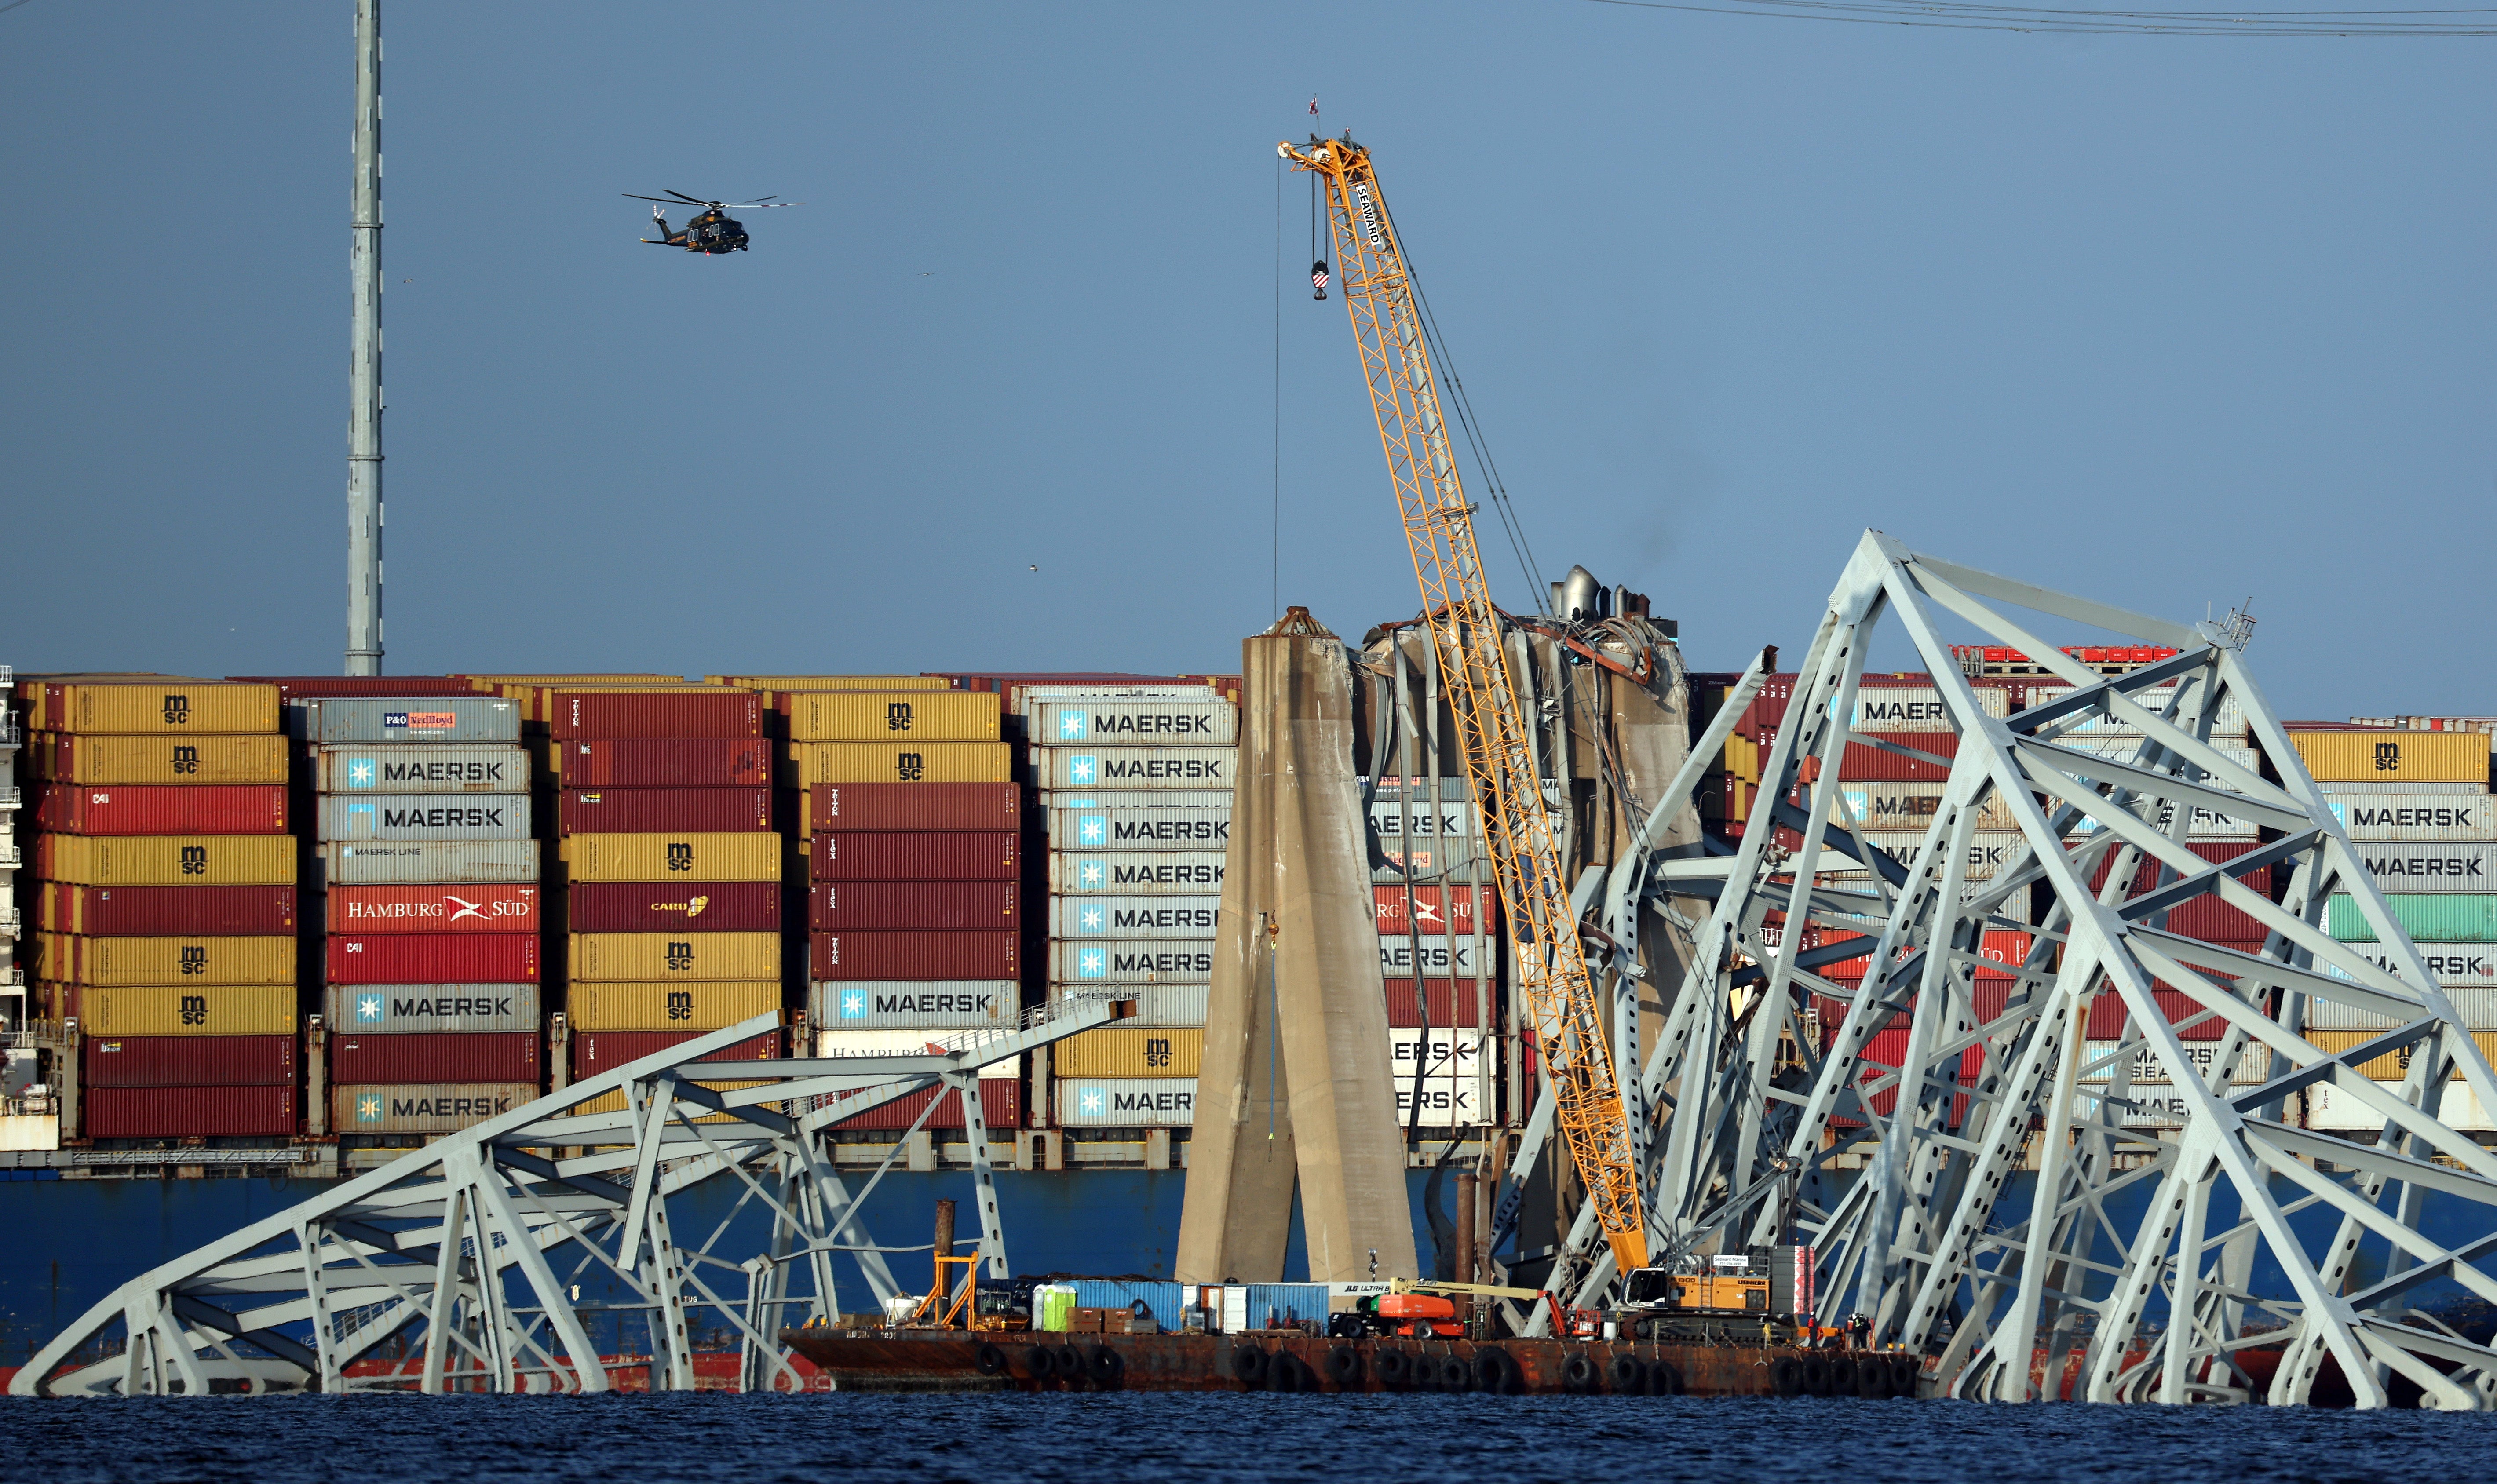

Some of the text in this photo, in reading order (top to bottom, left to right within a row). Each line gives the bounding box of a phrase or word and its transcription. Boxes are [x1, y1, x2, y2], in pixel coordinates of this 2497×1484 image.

[1358, 188, 1379, 243] SEAWARD
[1865, 702, 1942, 720] MAER
[410, 715, 453, 726] Nedlloyd
[1095, 715, 1211, 733] MAERSK
[385, 763, 504, 780] MAERSK
[1106, 760, 1221, 777] MAERSK
[93, 794, 109, 804] CAI
[384, 809, 503, 826] MAERSK
[2354, 808, 2471, 826] MAERSK
[1115, 821, 1230, 839] MAERSK
[1115, 865, 1225, 883] MAERSK
[2366, 858, 2483, 876] MAERSK
[348, 900, 529, 918] HAMBURG SÜD
[1115, 909, 1218, 927] MAERS
[347, 943, 362, 952] CAI
[1115, 954, 1211, 971] MAERS
[394, 998, 511, 1016] MAERSK
[876, 994, 993, 1013] MAERSK
[393, 1098, 511, 1116] MAERSK
[1115, 1093, 1195, 1110] MAER
[1396, 1092, 1468, 1109] ERSK
